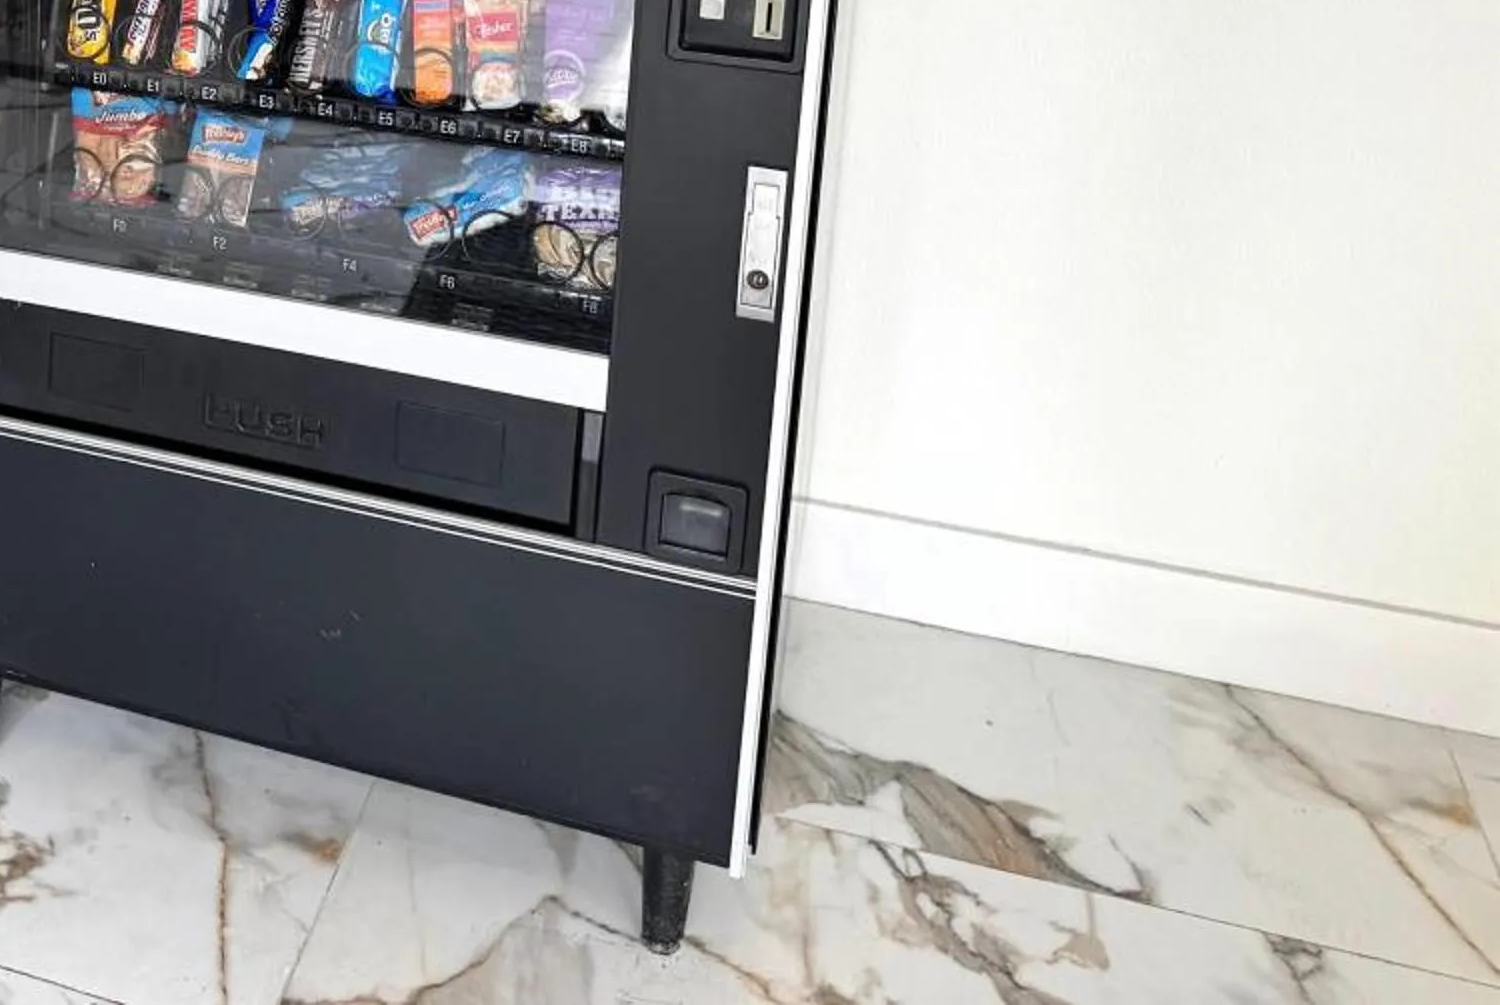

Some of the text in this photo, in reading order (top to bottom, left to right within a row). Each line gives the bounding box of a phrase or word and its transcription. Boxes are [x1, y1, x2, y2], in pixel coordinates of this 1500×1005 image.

[93, 72, 107, 85] E0
[147, 80, 160, 92] E1
[201, 87, 217, 101] E2
[259, 95, 275, 109] E3
[317, 102, 334, 116] E4
[378, 112, 394, 126] E5
[440, 120, 457, 134] E6
[503, 129, 521, 144] E7
[212, 236, 227, 250] F2
